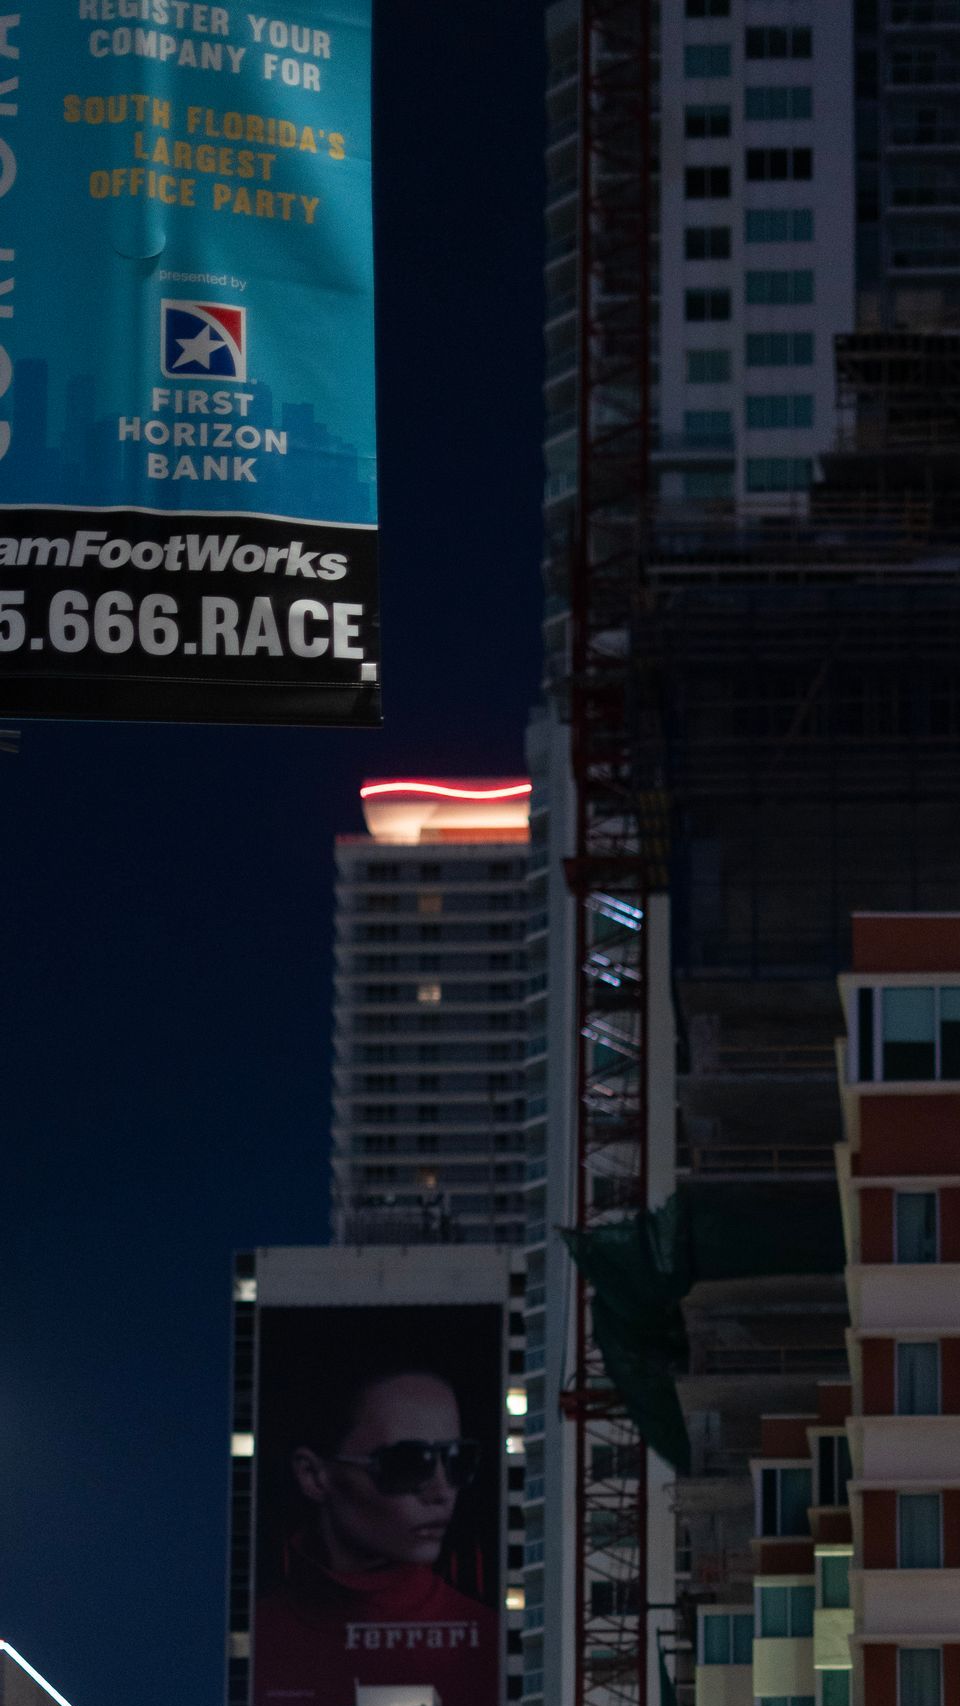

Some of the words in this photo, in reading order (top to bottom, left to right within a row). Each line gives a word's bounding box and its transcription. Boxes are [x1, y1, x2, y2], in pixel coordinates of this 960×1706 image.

[79, 0, 229, 36] REGISTER
[248, 14, 331, 59] YOUR
[89, 27, 245, 74] COMPANY
[263, 53, 321, 91] FOR
[63, 94, 170, 129] SOUTH
[187, 106, 346, 160] FLORIDA'S
[134, 131, 276, 181] LARGEST
[89, 168, 196, 206] OFFICE
[213, 184, 320, 224] PARTY
[159, 269, 228, 287] presented
[231, 276, 247, 291] by
[152, 387, 254, 417] FIRST
[118, 416, 287, 454] HORIZON
[147, 453, 257, 482] BANK
[346, 1621, 479, 1649] Ferrari
